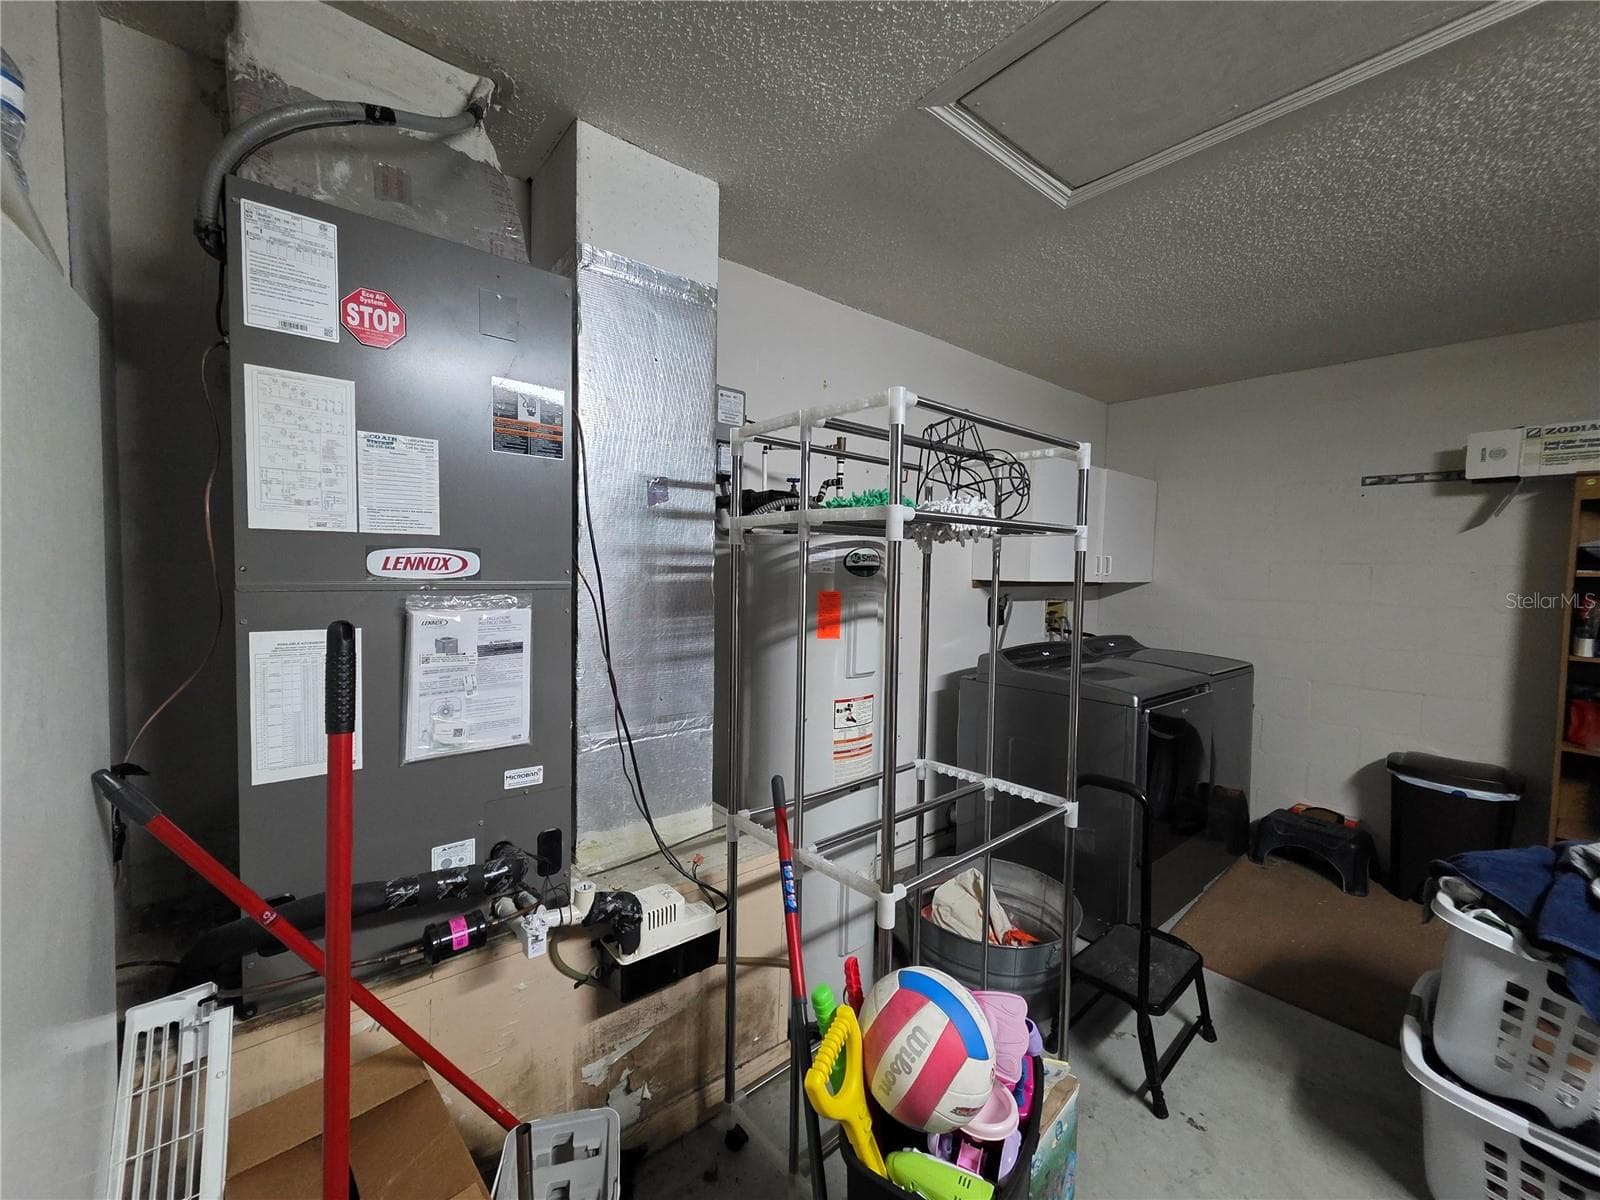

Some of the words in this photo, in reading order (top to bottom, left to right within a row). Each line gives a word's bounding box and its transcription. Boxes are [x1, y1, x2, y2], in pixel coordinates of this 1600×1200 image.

[361, 290, 375, 298] Eco
[360, 296, 387, 307] Systems
[346, 302, 400, 333] STOP
[1545, 423, 1600, 435] ZODIA
[381, 555, 453, 571] LENNOX
[878, 1025, 931, 1097] Wilson
